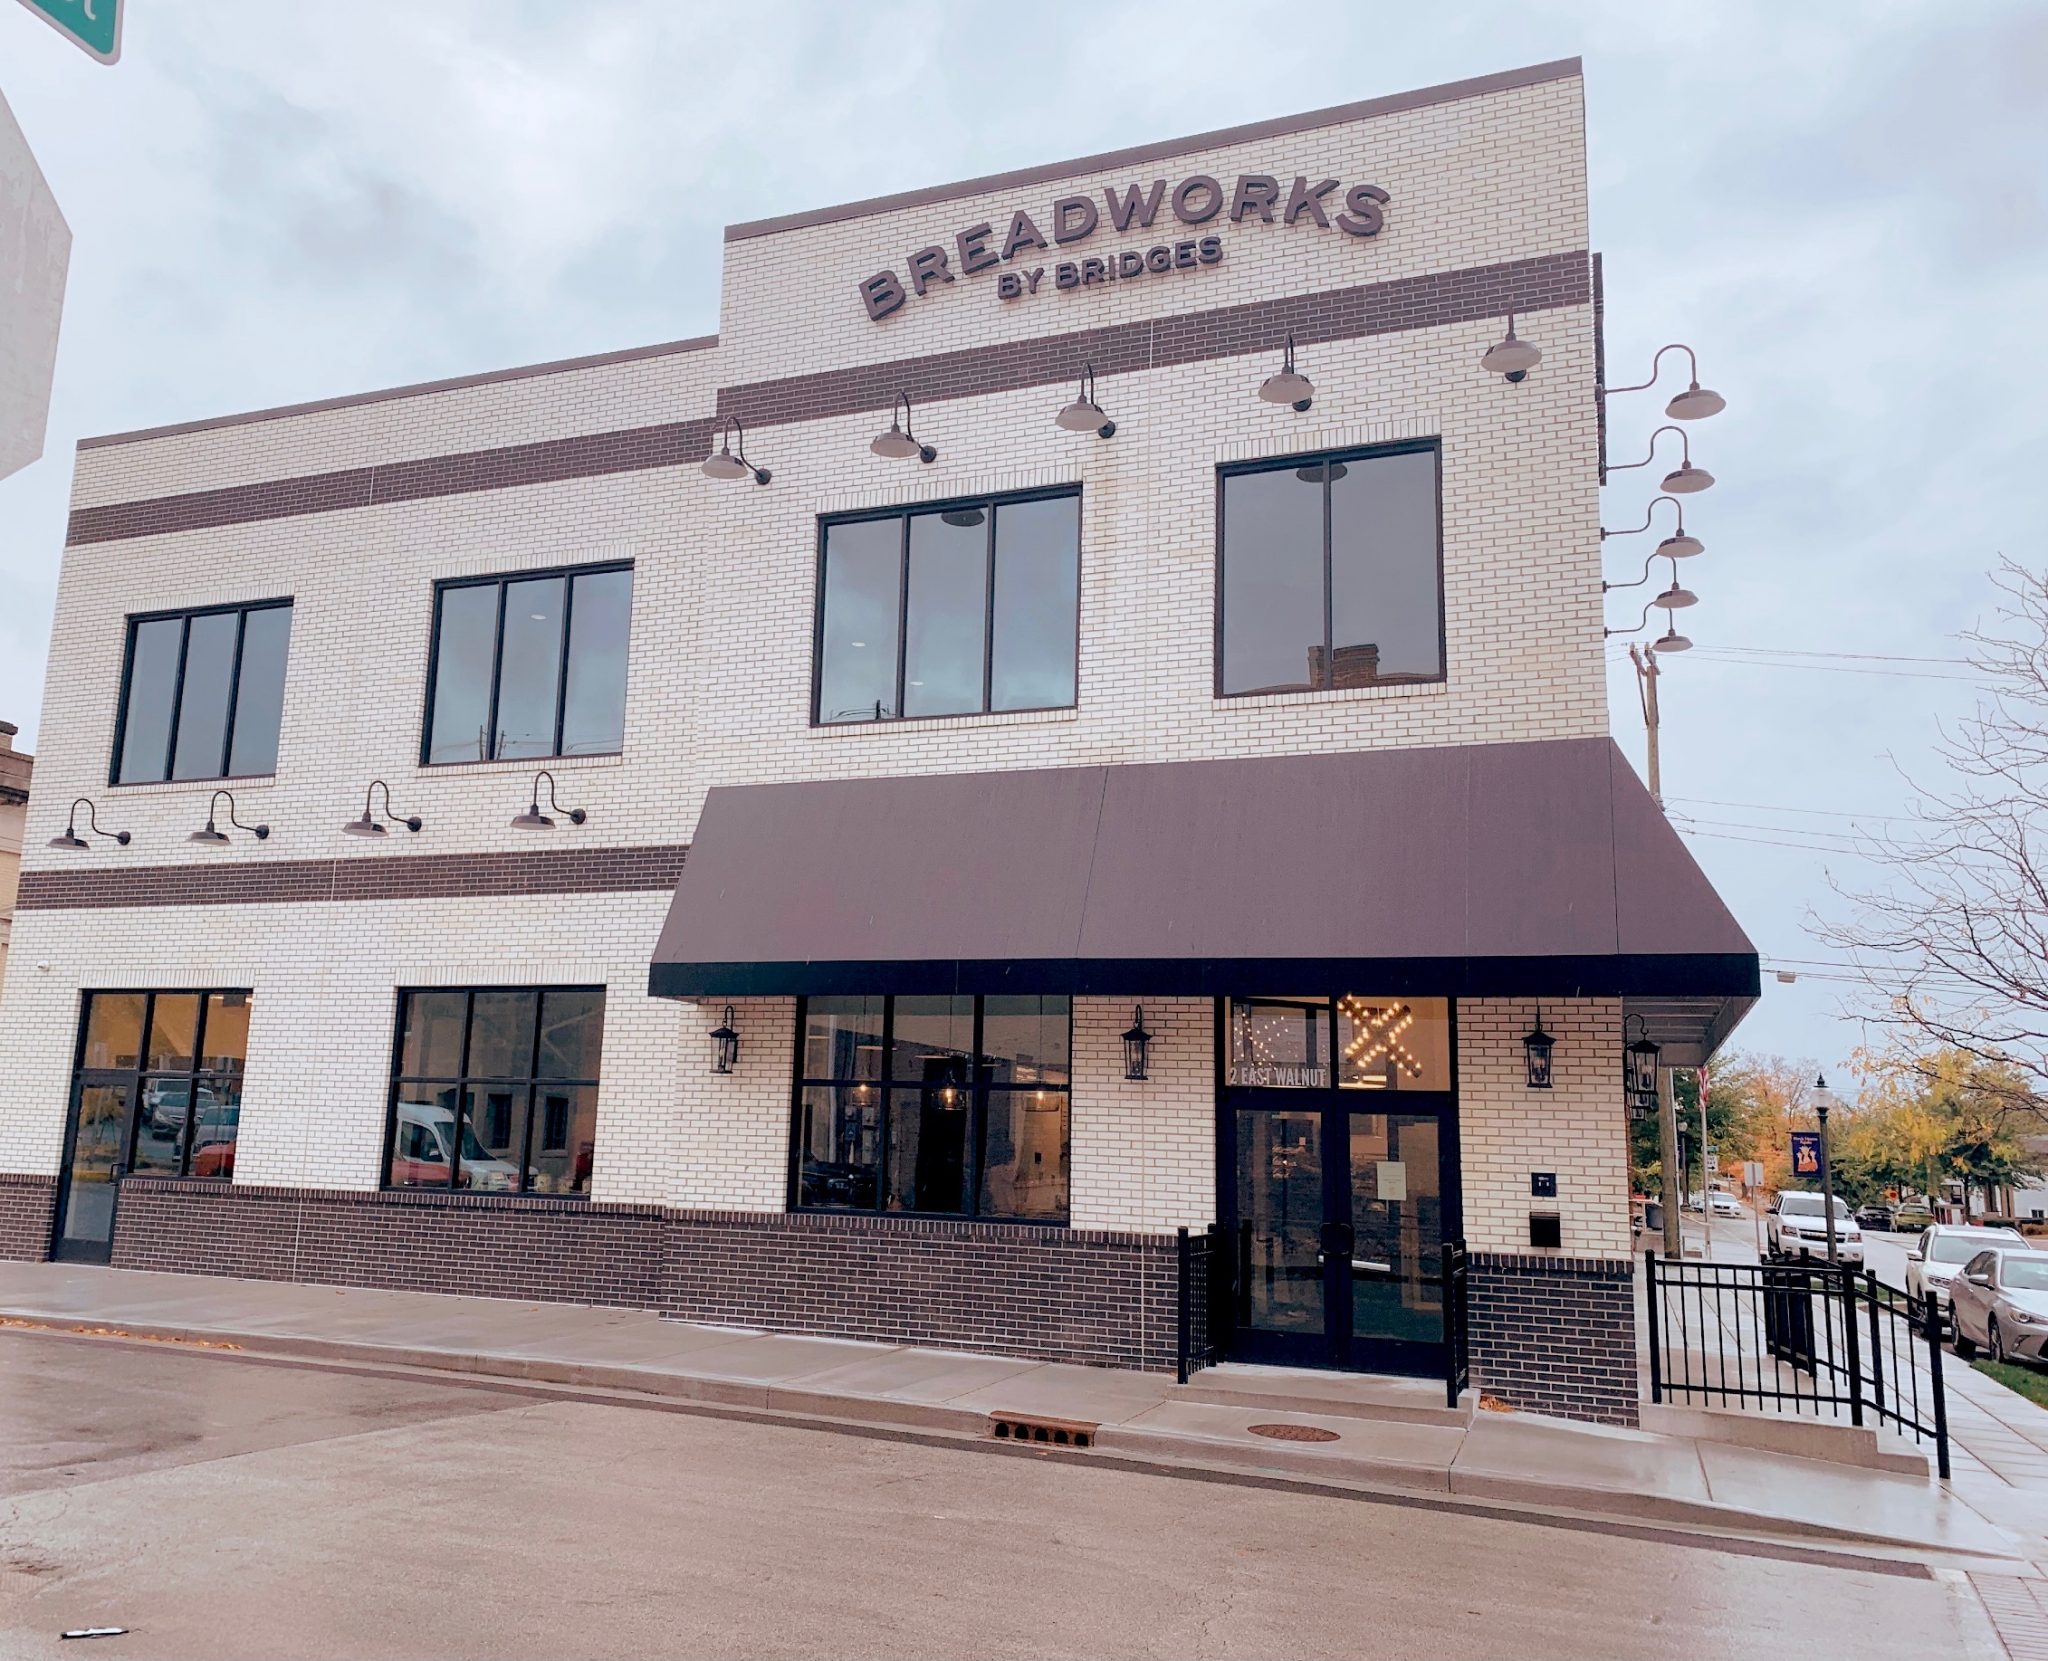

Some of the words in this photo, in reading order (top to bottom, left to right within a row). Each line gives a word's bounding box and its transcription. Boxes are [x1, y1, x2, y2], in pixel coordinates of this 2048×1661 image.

[858, 175, 1391, 321] BREADWORKS
[998, 267, 1045, 299] BY
[1055, 236, 1223, 290] BRIDGES
[1241, 1067, 1272, 1085] EAST
[1276, 1068, 1326, 1087] WALNUT
